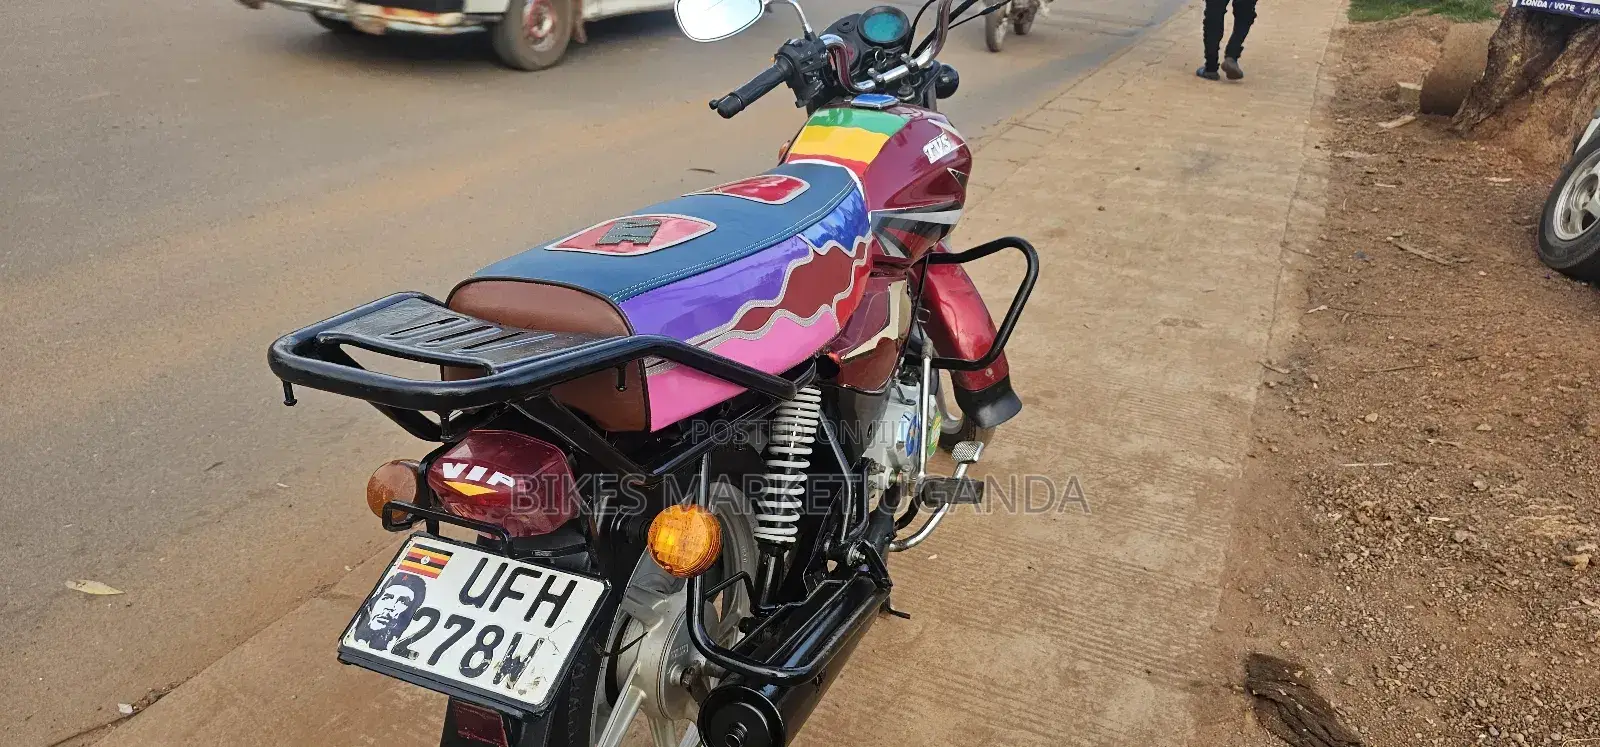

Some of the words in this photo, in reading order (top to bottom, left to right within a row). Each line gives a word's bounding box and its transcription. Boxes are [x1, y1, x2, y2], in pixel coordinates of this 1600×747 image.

[1554, 2, 1576, 12] VOTE
[442, 462, 516, 488] VIP
[458, 556, 579, 629] UFH
[391, 606, 546, 690] 278W
